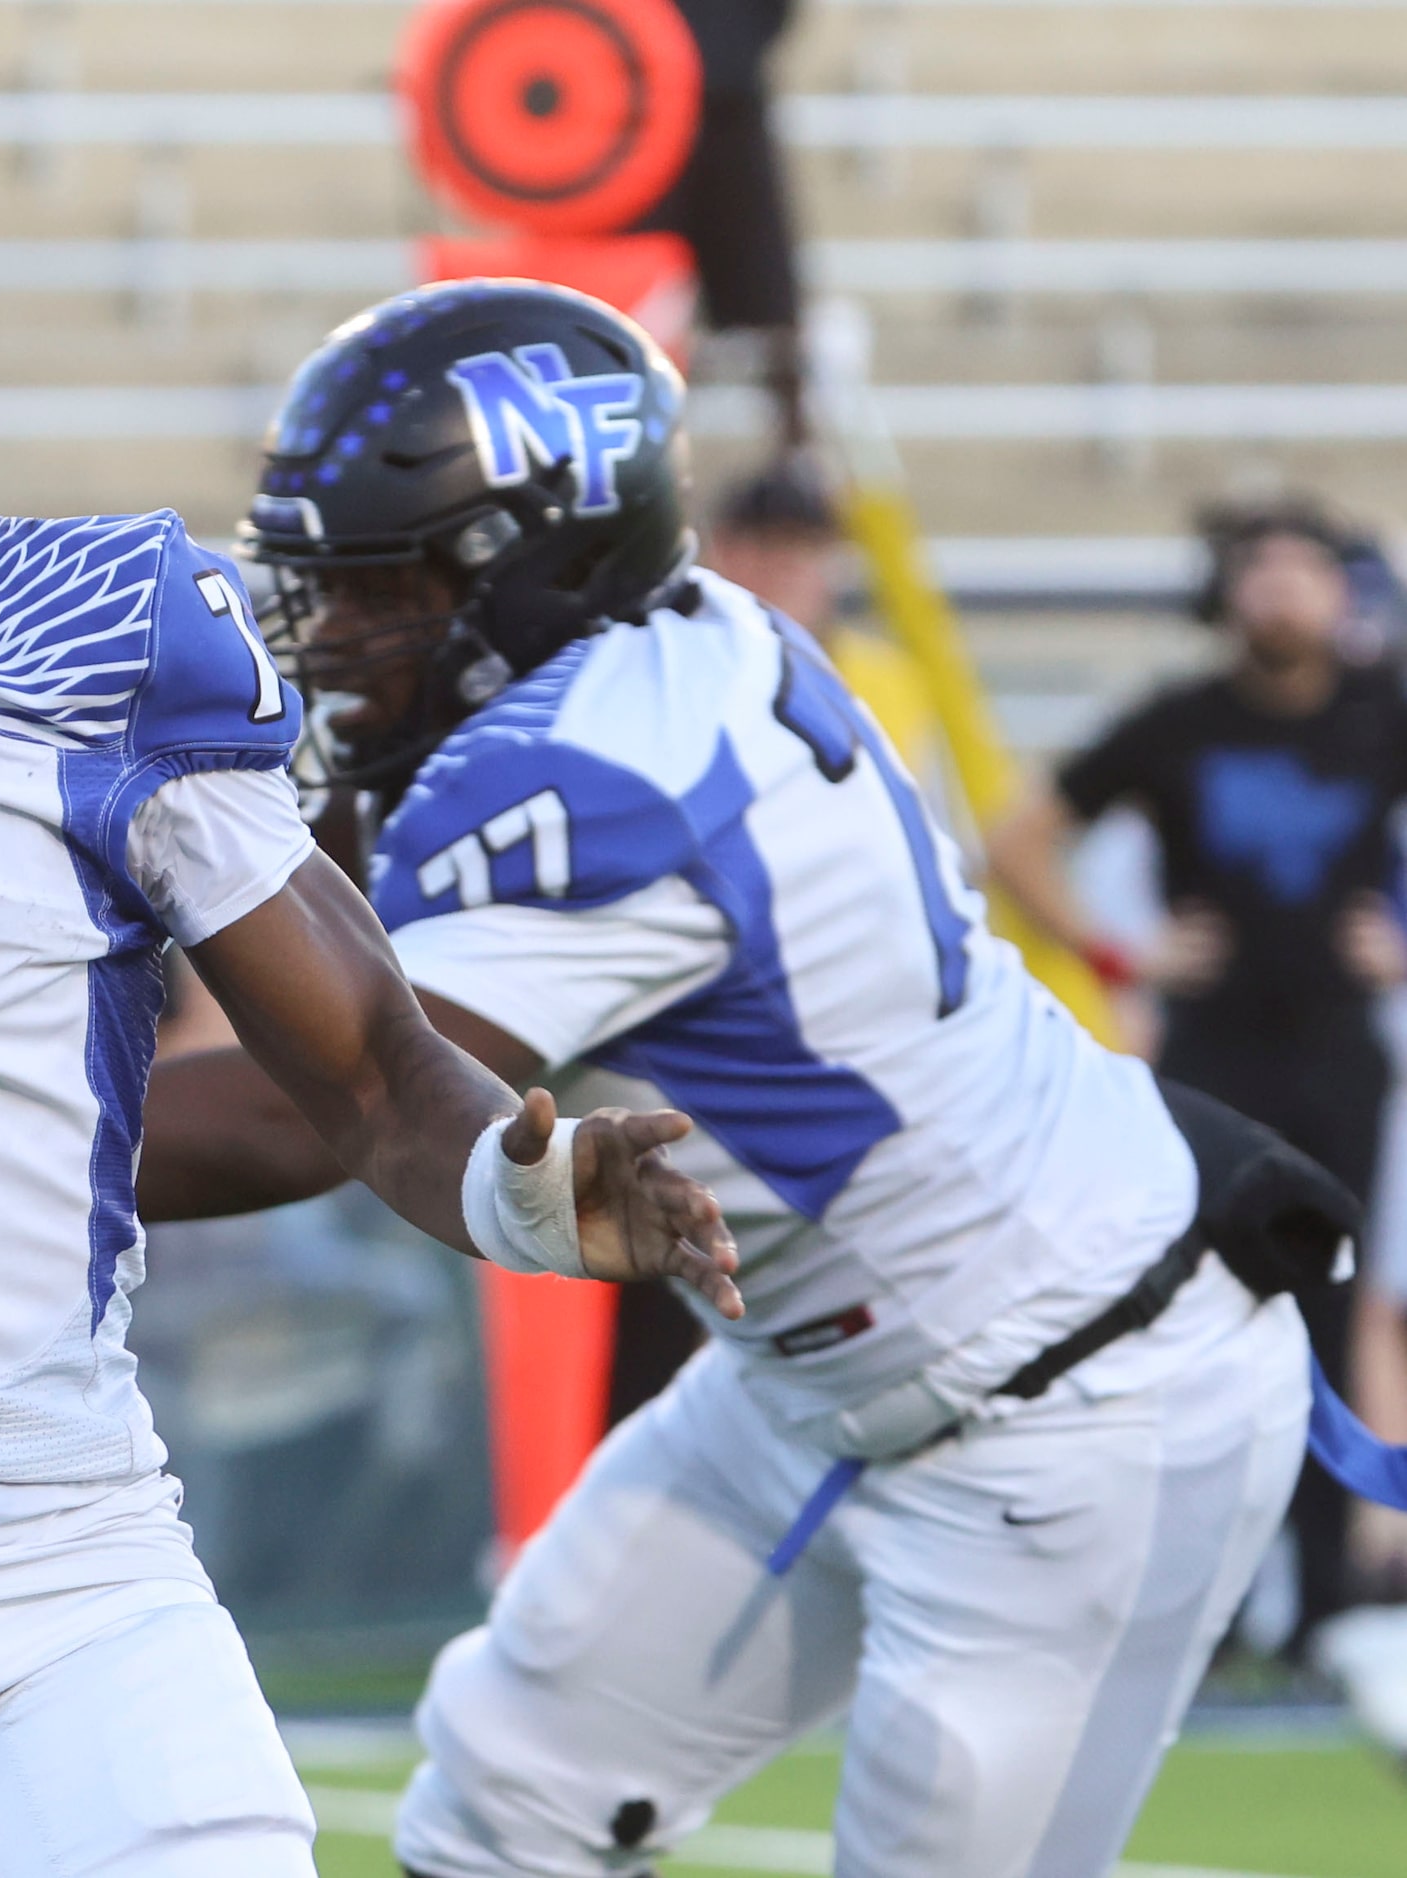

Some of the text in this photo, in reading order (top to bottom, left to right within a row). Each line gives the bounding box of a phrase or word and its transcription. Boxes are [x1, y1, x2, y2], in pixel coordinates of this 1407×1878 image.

[445, 341, 645, 518] NF
[192, 568, 285, 725] 7
[416, 786, 573, 912] 77
